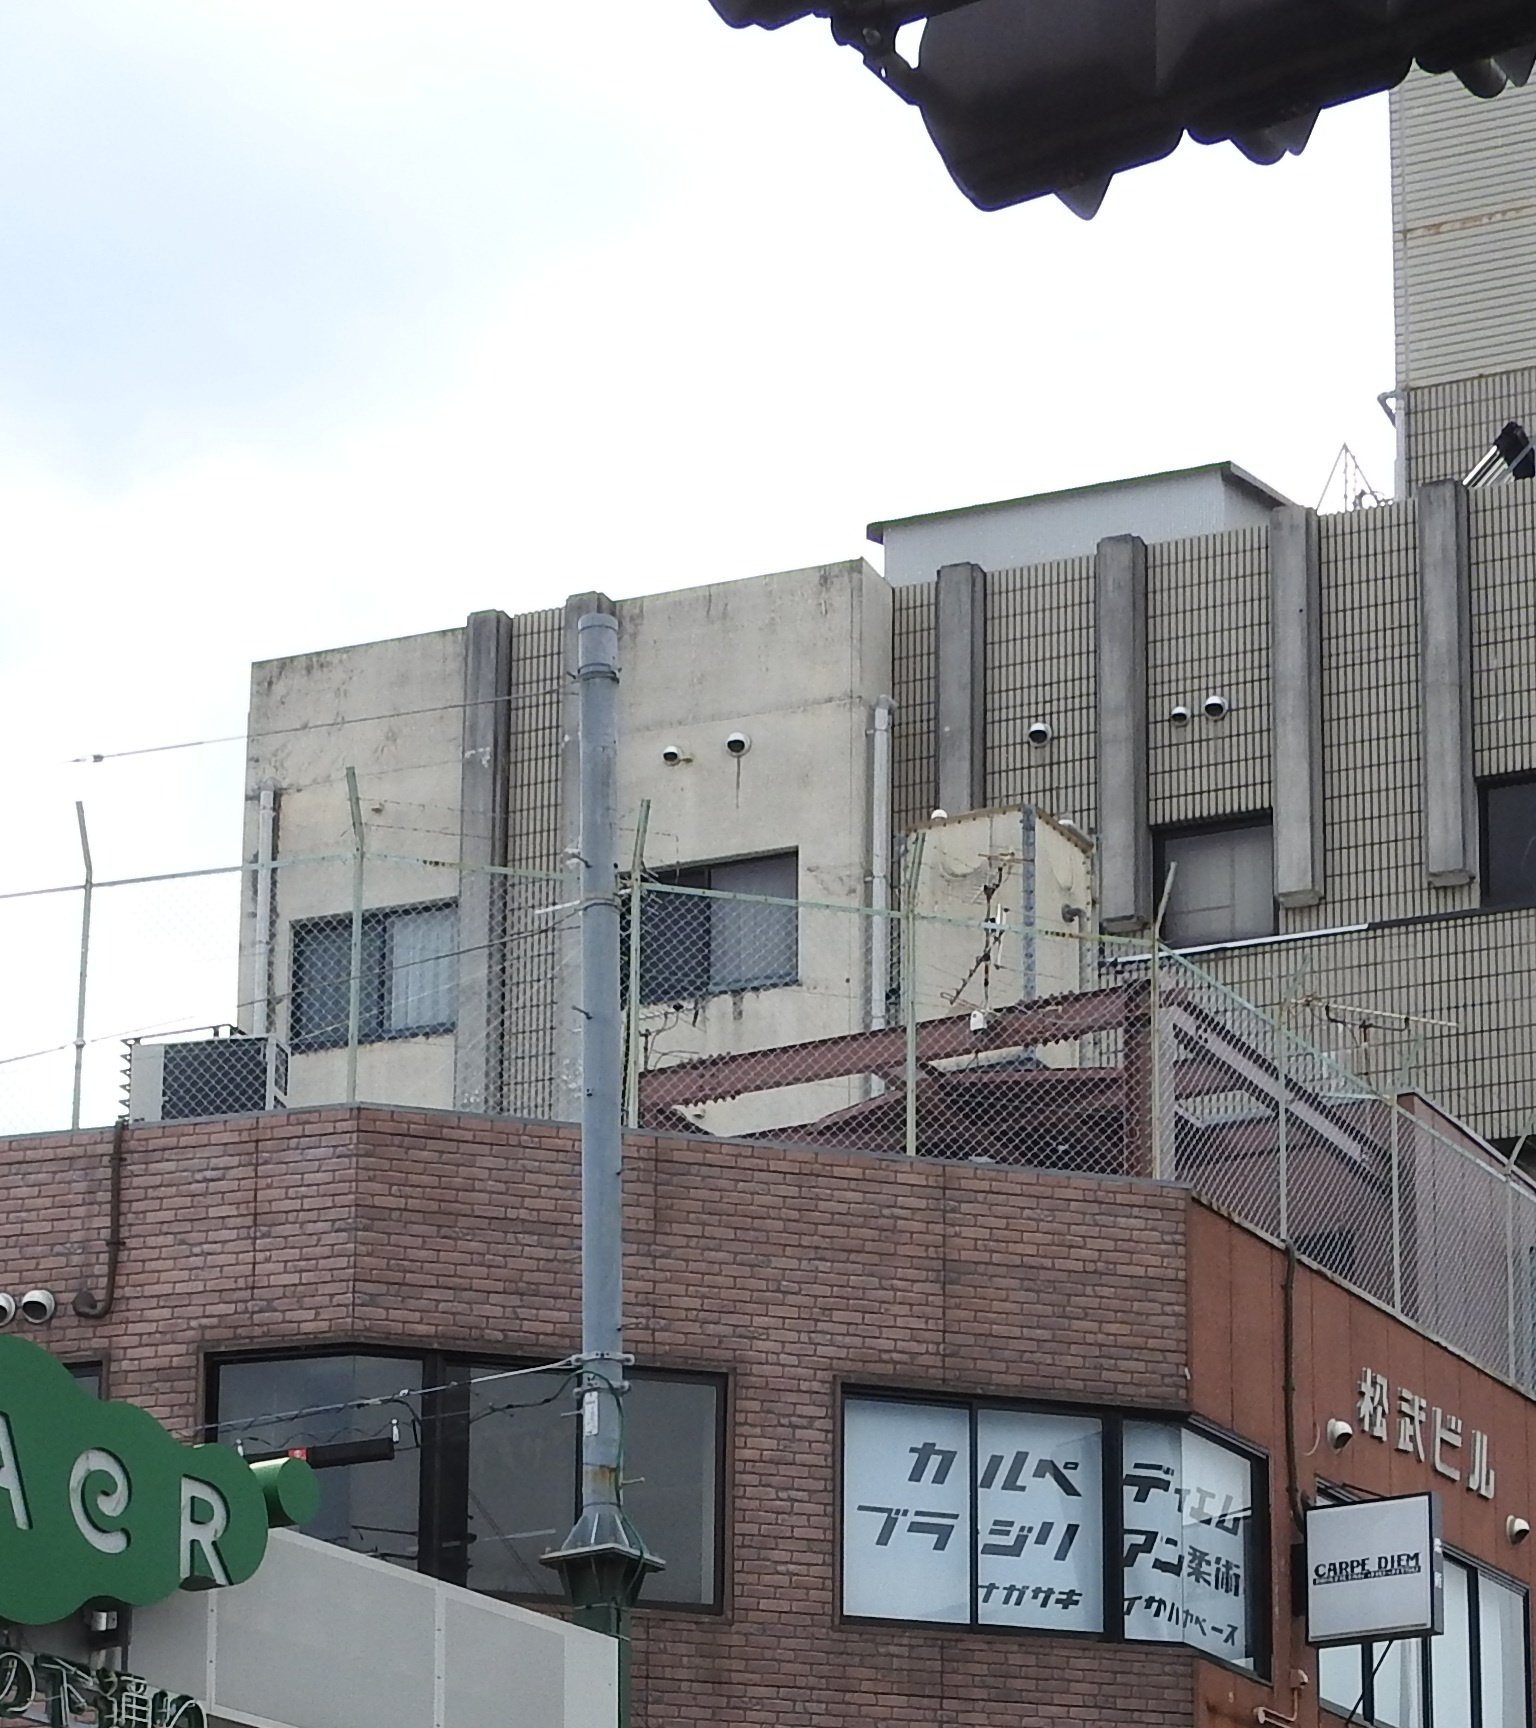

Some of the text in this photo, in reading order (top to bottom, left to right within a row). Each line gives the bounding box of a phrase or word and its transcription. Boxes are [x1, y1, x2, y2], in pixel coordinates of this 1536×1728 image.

[1356, 1367, 1495, 1499] 松武ビル
[1314, 1557, 1370, 1578] CARPE
[1378, 1552, 1420, 1570] DIEM
